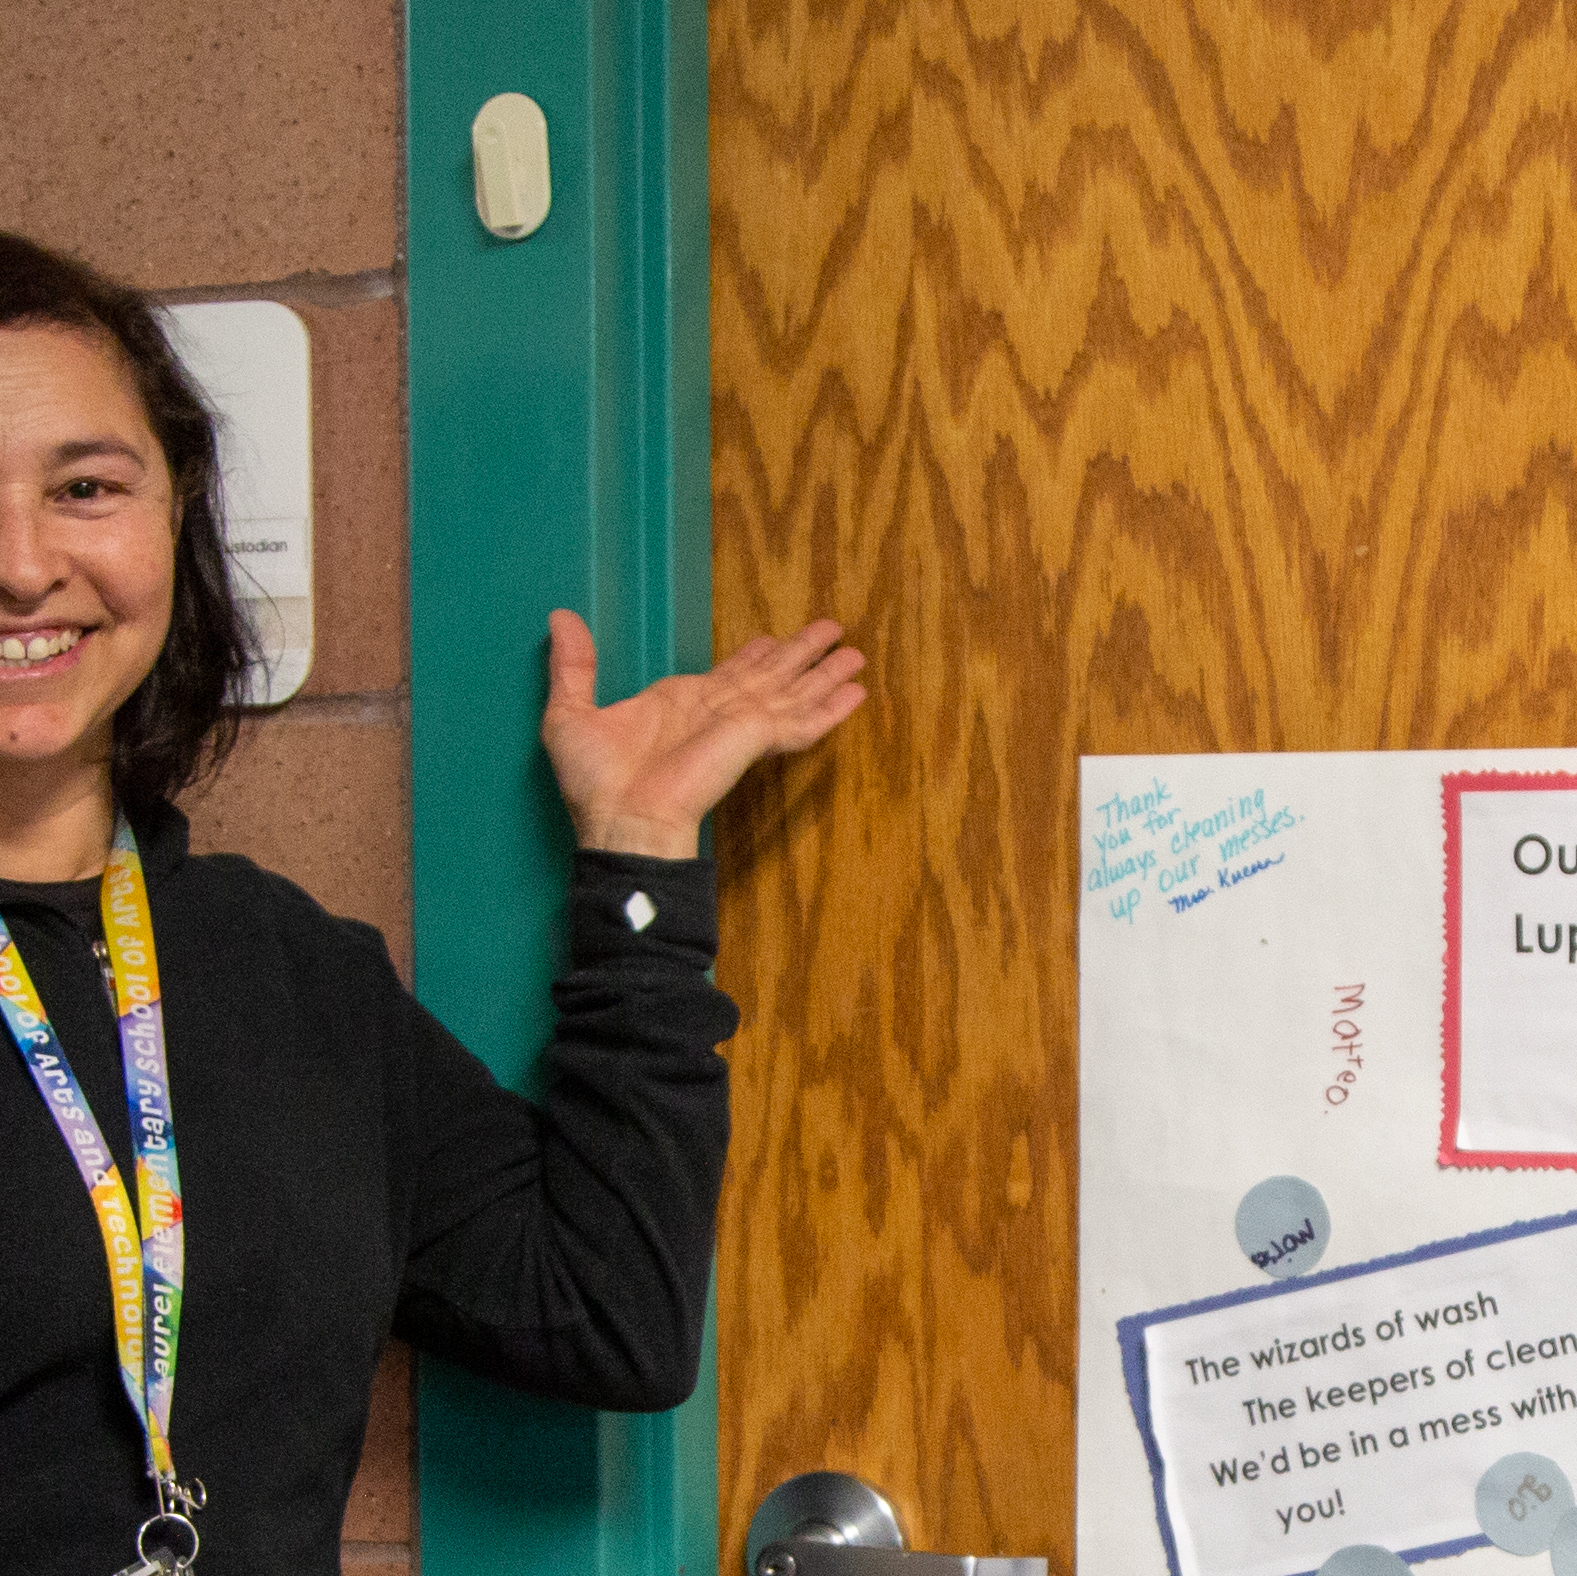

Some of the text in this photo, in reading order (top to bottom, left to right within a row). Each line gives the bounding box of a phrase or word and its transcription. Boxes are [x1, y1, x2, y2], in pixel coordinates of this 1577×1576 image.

[1087, 787, 1268, 892] always cleaning
[1096, 776, 1173, 828] Thank
[1142, 806, 1182, 836] for
[1109, 887, 1142, 925] up
[35, 1052, 85, 1123] Arts
[74, 1127, 118, 1187] and
[1185, 1290, 1500, 1386] The wizards of wash
[1242, 1398, 1298, 1428] The
[1305, 1362, 1436, 1414] keepers
[1445, 1348, 1477, 1382] of
[1209, 1446, 1291, 1489] We'd
[1299, 1441, 1343, 1470] be
[1348, 1429, 1380, 1459] in
[1388, 1425, 1410, 1448] a
[1418, 1402, 1503, 1444] mess
[1276, 1488, 1347, 1536] you!
